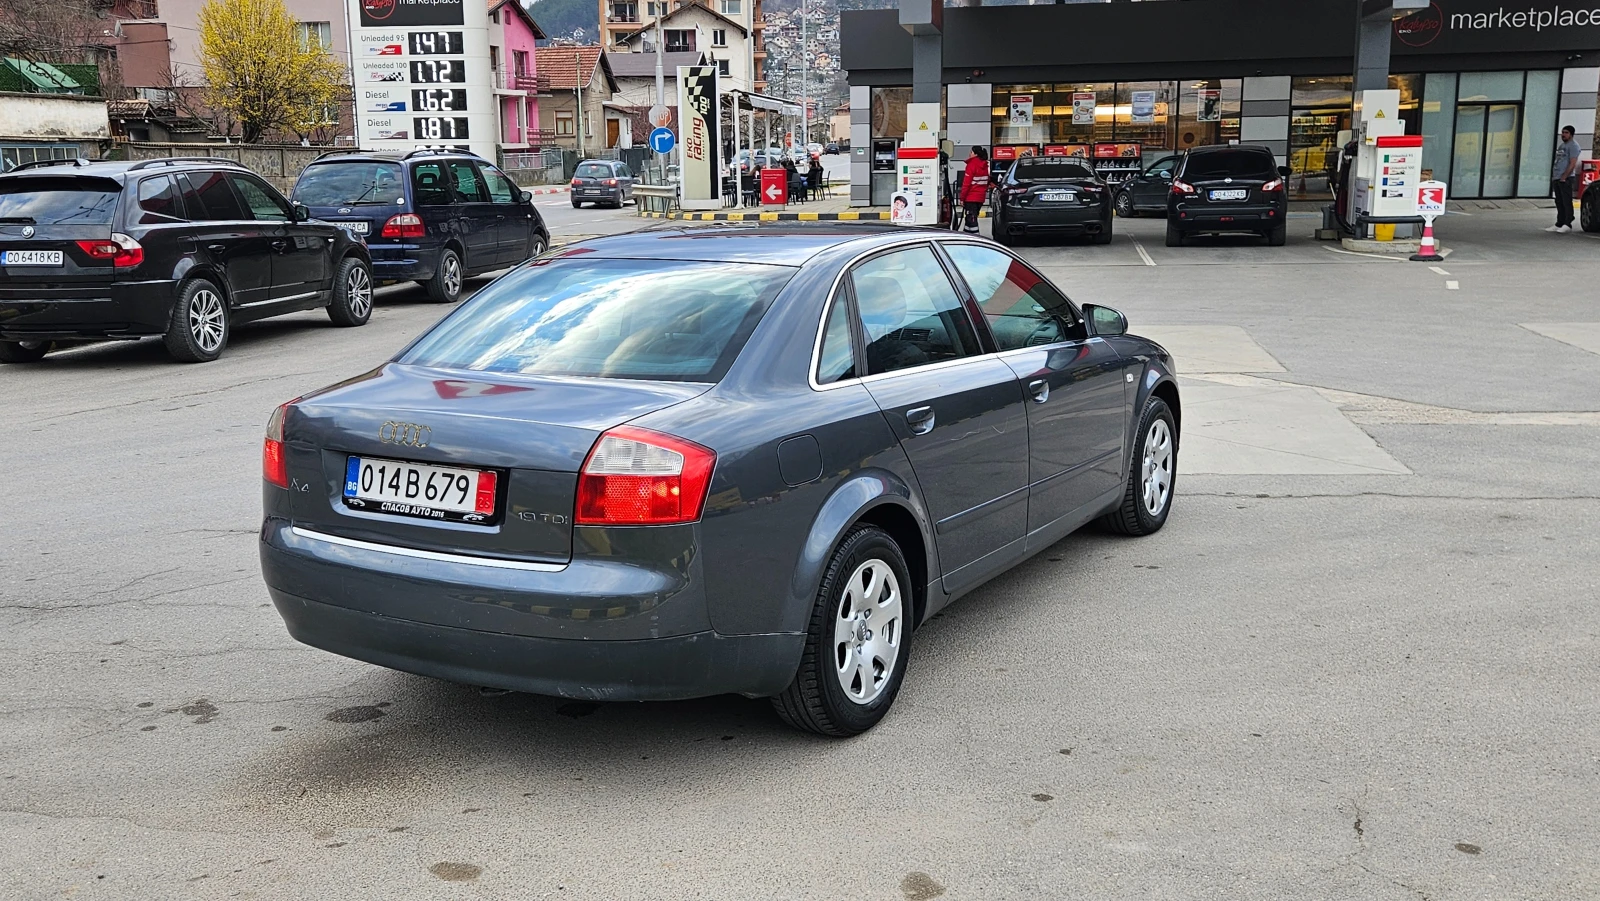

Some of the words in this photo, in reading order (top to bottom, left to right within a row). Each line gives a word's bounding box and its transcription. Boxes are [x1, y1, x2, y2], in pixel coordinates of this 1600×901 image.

[1451, 6, 1600, 32] marketplace
[416, 32, 450, 54] 1.47
[417, 60, 451, 83] 1.72
[365, 91, 389, 99] Diesel
[419, 89, 453, 111] 1.62
[700, 96, 708, 115] 100
[367, 119, 391, 127] Diesel
[421, 117, 455, 139] 1.87
[693, 117, 704, 161] racing
[291, 477, 309, 493] A4
[347, 481, 357, 491] BG
[361, 464, 470, 505] 014B679
[381, 502, 410, 513] СПАСОВ
[411, 507, 431, 517] АУТО
[431, 510, 445, 518] 2016
